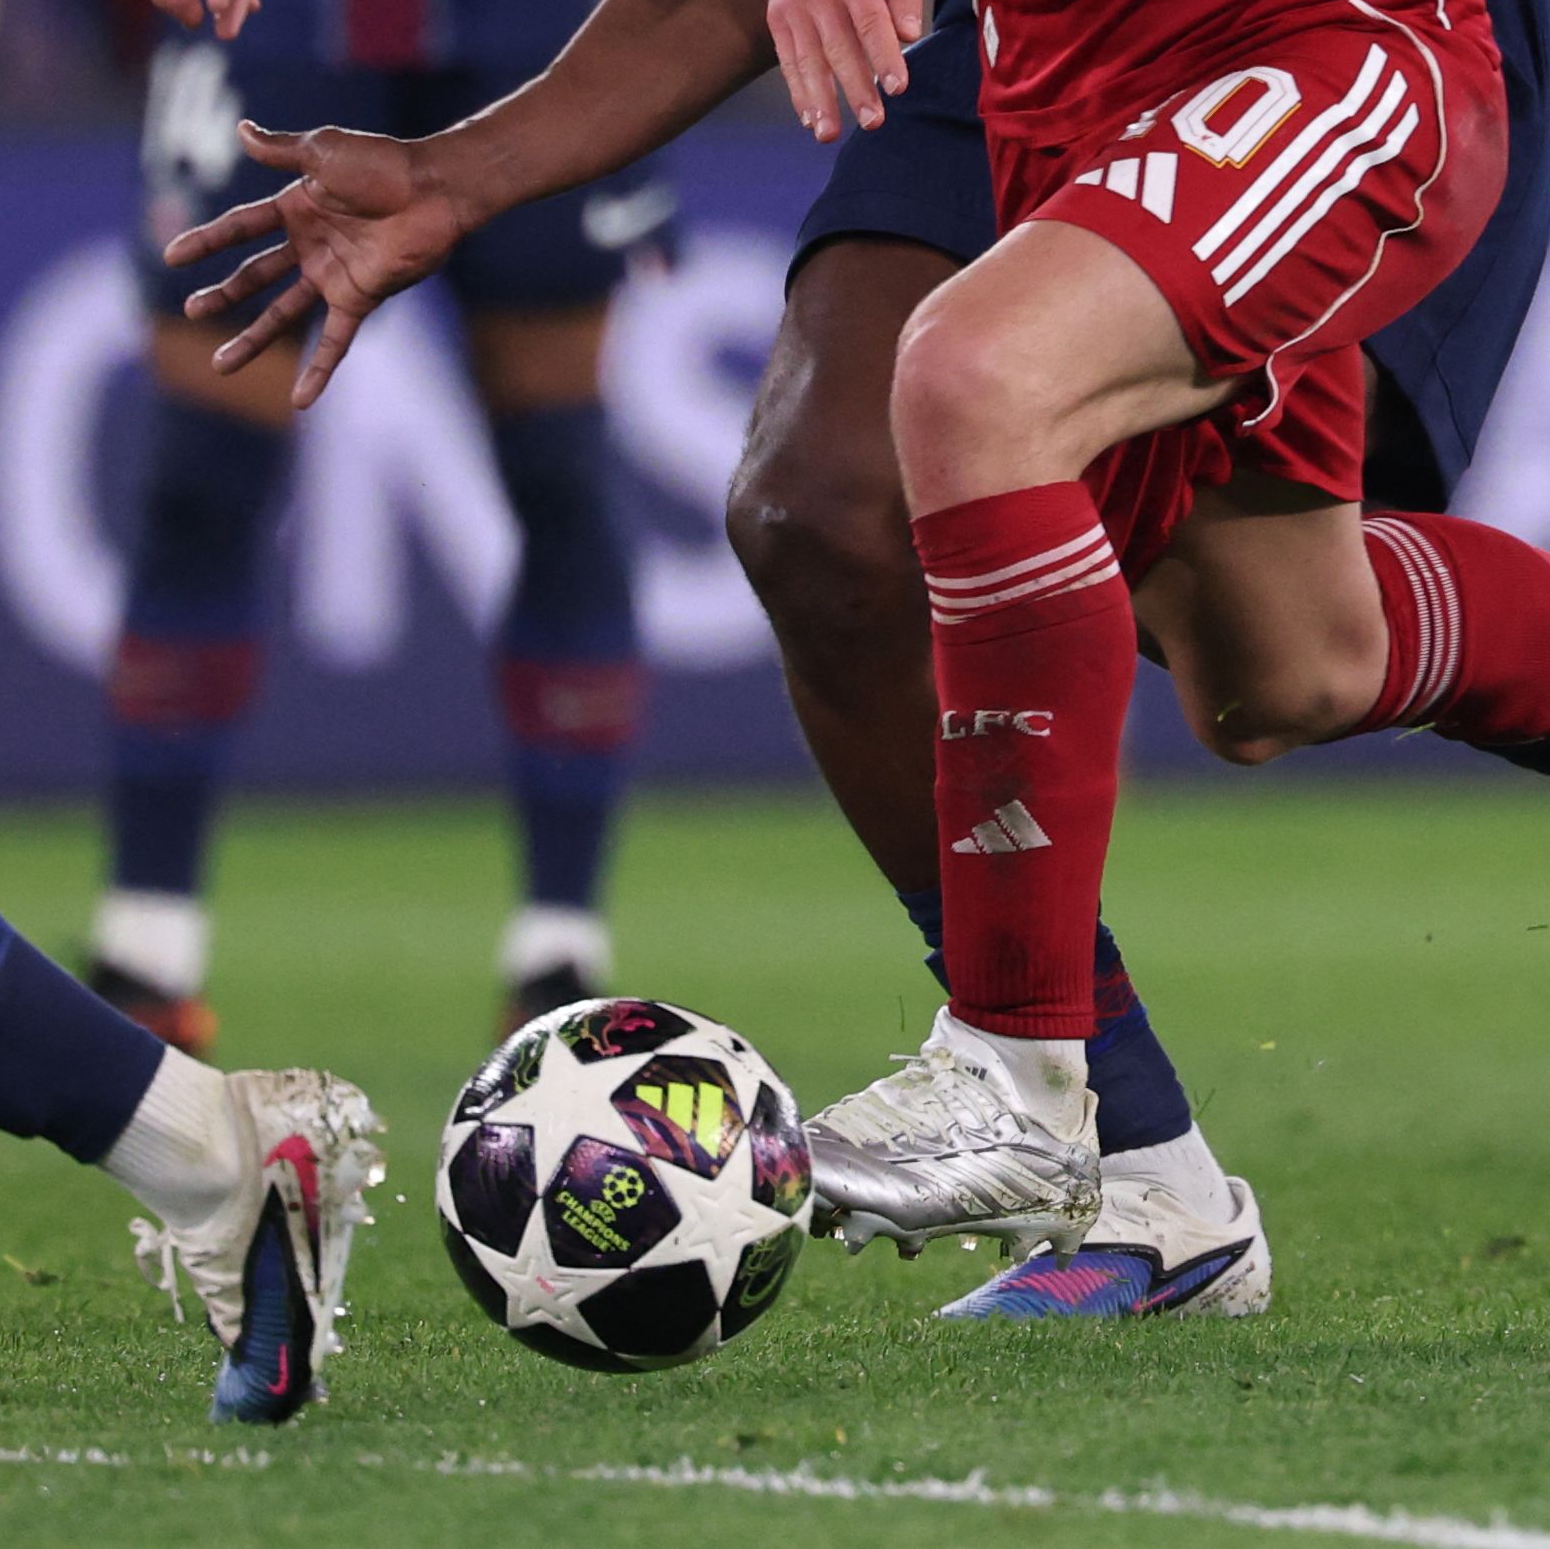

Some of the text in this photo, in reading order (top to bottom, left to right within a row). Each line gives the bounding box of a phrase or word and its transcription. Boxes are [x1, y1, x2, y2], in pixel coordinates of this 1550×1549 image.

[941, 710, 1054, 740] LFC
[556, 1191, 632, 1251] CHAMPIONS
[562, 1210, 611, 1253] LEAGUE
